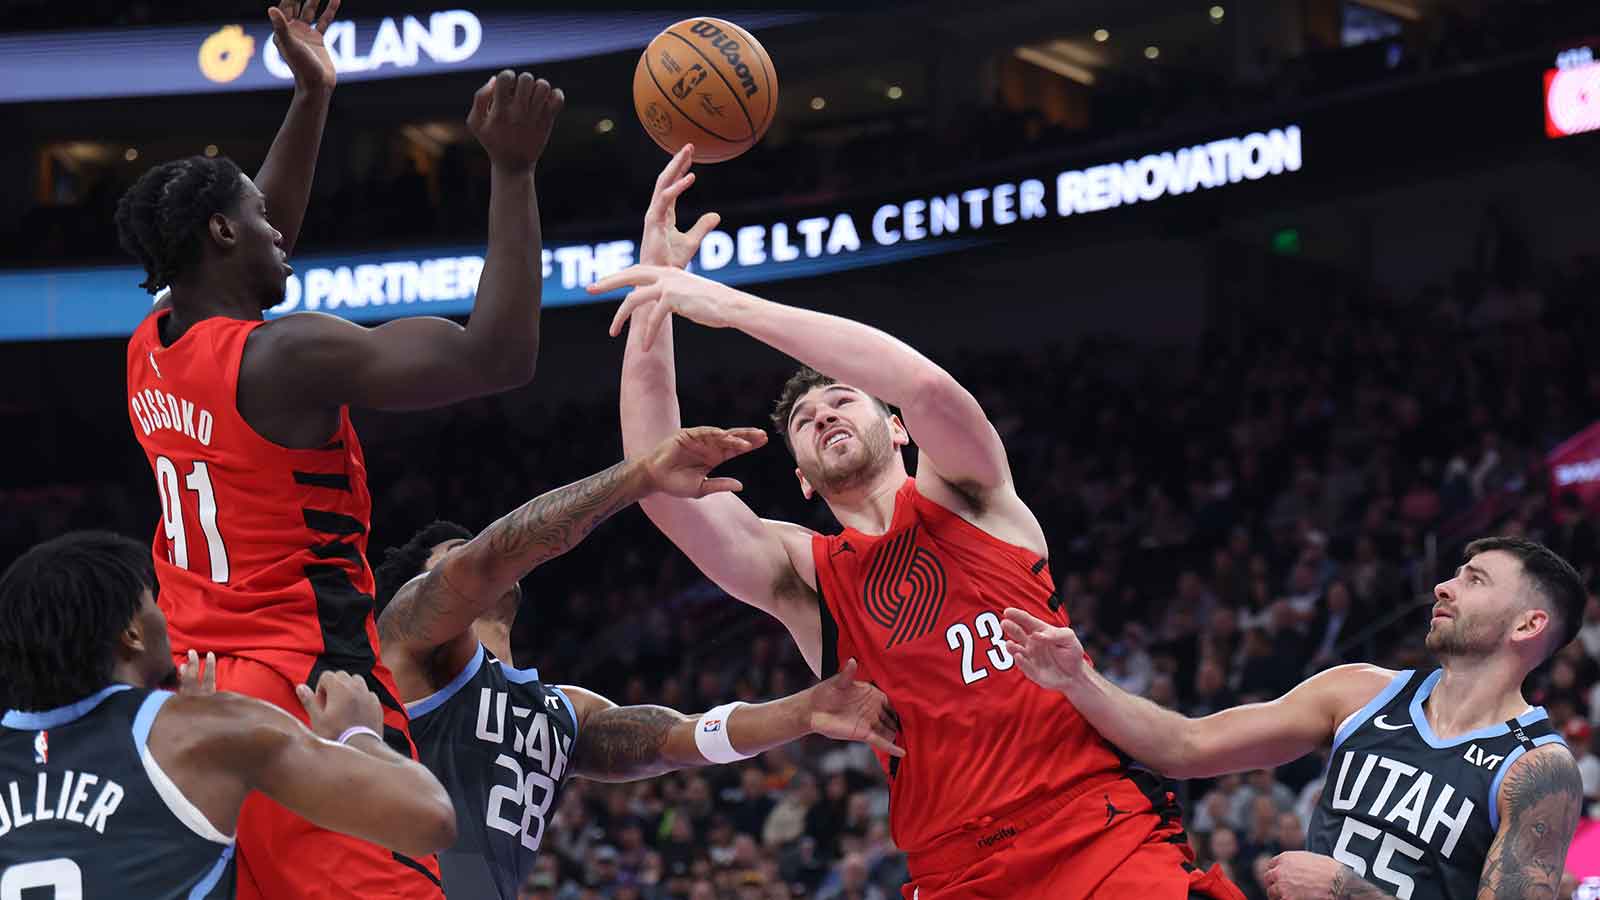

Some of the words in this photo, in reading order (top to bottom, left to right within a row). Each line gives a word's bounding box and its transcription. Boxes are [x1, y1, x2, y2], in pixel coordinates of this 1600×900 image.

[690, 21, 758, 98] Wilson
[304, 256, 485, 310] PARTNER
[555, 240, 634, 289] THE
[700, 213, 861, 271] DELTA
[872, 179, 1046, 246] CENTER
[1056, 125, 1302, 217] RENOVATION
[131, 388, 213, 447] CISSOKO
[155, 455, 229, 584] 91
[946, 610, 1015, 686] 23
[476, 687, 572, 781] UTAH
[1463, 743, 1504, 771] LVT
[486, 753, 554, 851] 28
[1332, 751, 1475, 859] UTAH
[1333, 816, 1425, 900] 55
